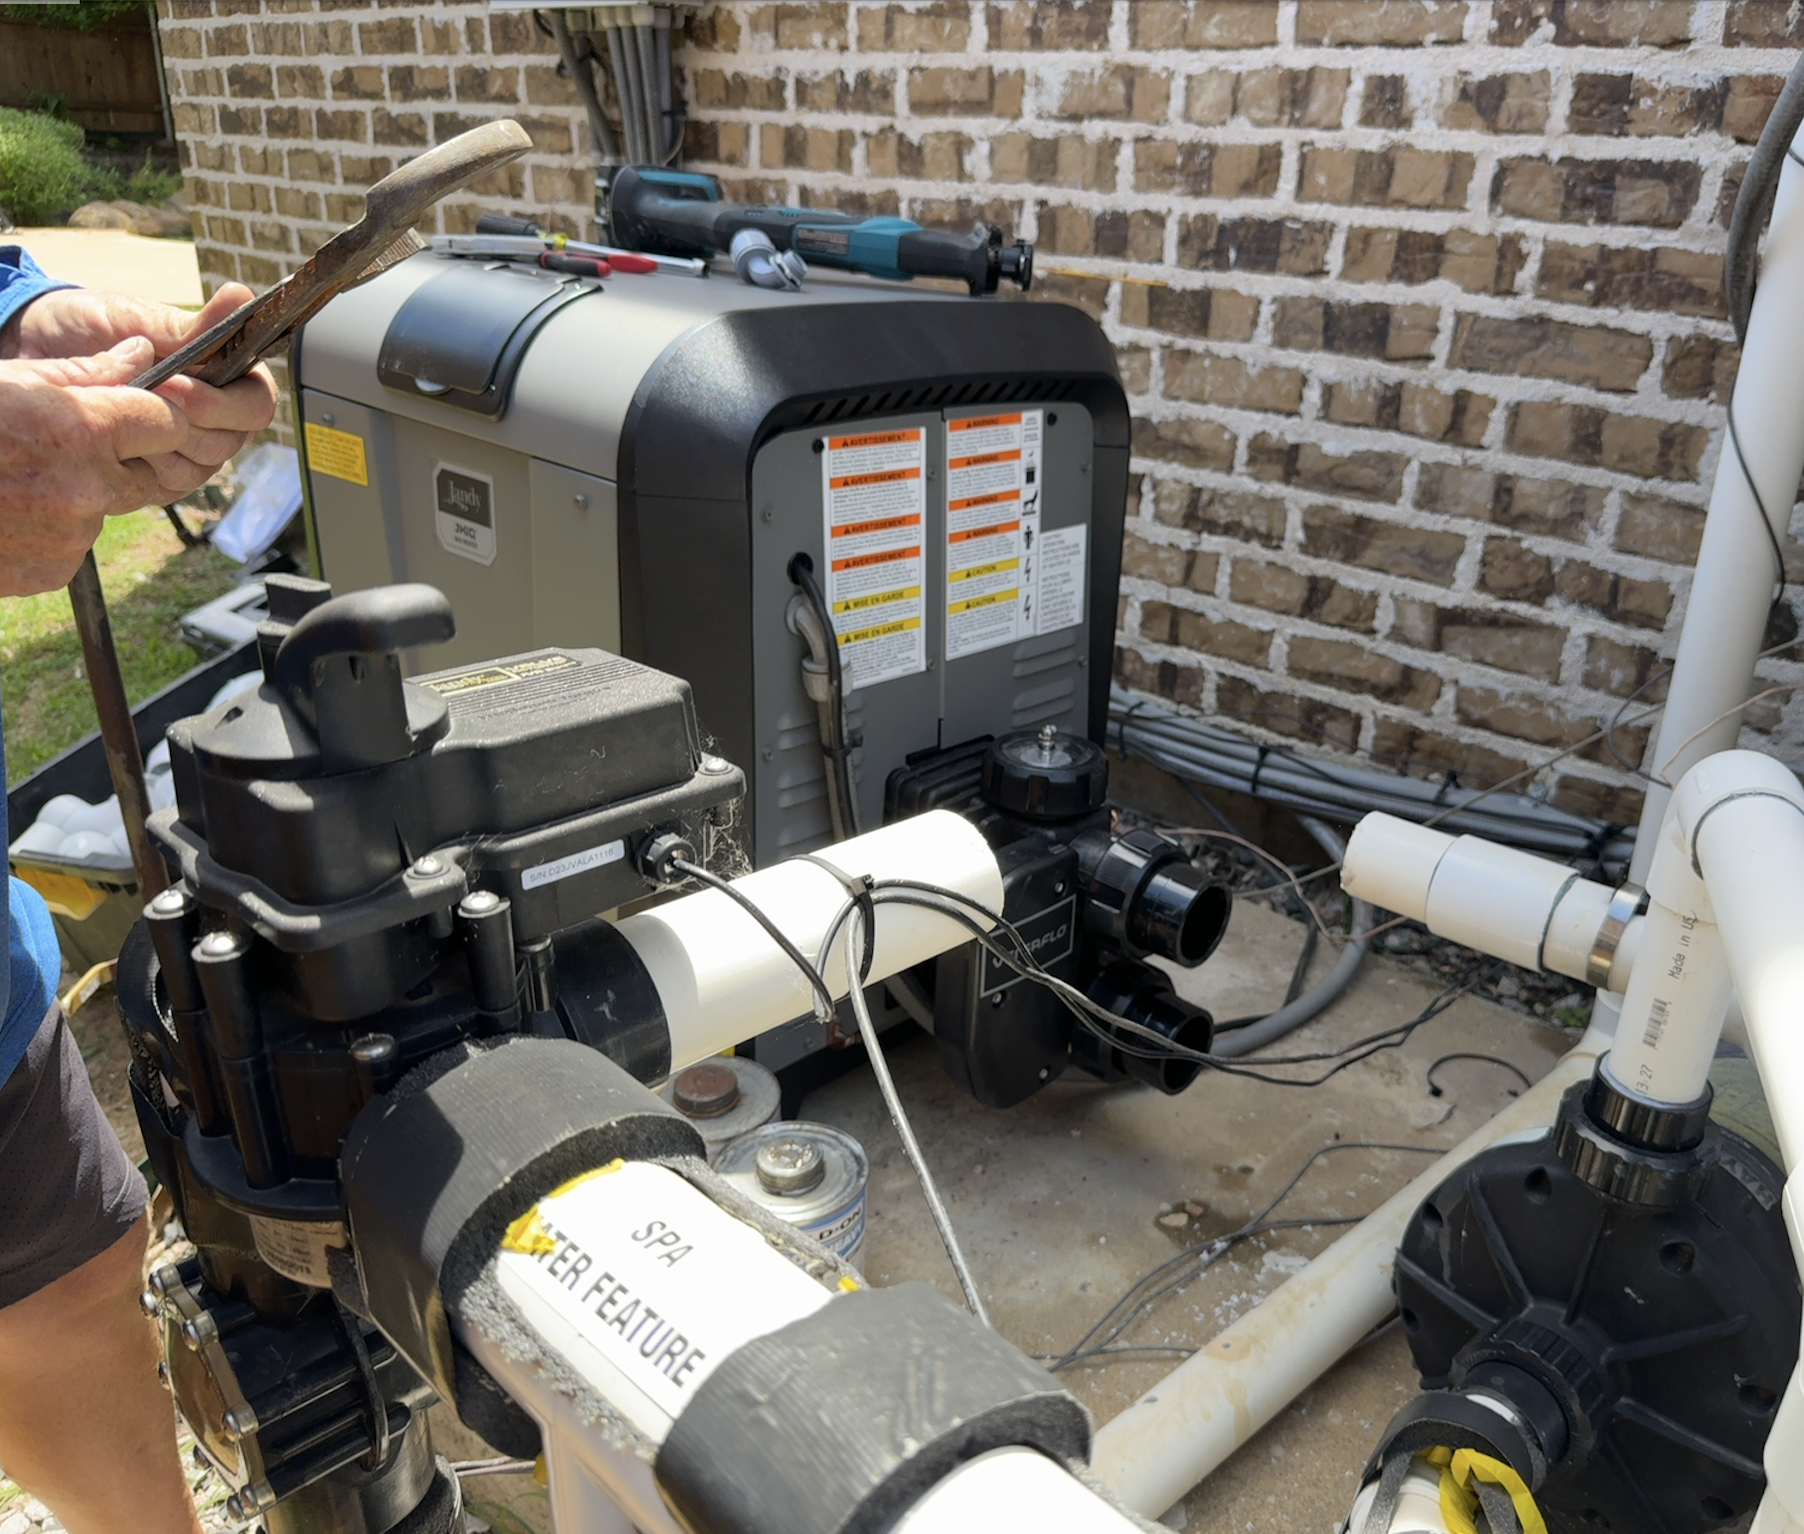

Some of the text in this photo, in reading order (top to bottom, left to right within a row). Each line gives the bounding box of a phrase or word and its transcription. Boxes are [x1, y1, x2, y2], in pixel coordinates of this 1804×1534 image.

[851, 432, 906, 446] AVERTISSEMENT
[851, 472, 905, 485] AVERTISSEMENT
[444, 480, 482, 514] Jandy
[852, 518, 906, 534] AVERTISSEMENT
[852, 551, 906, 567] AVERTISSEMENT
[853, 591, 904, 609] MISE EN GARDE
[854, 623, 904, 641] MISE EN GARDE
[1667, 952, 1686, 980] Made
[1677, 935, 1691, 947] in
[631, 1220, 694, 1268] SPA
[580, 1271, 706, 1388] FEATURE
